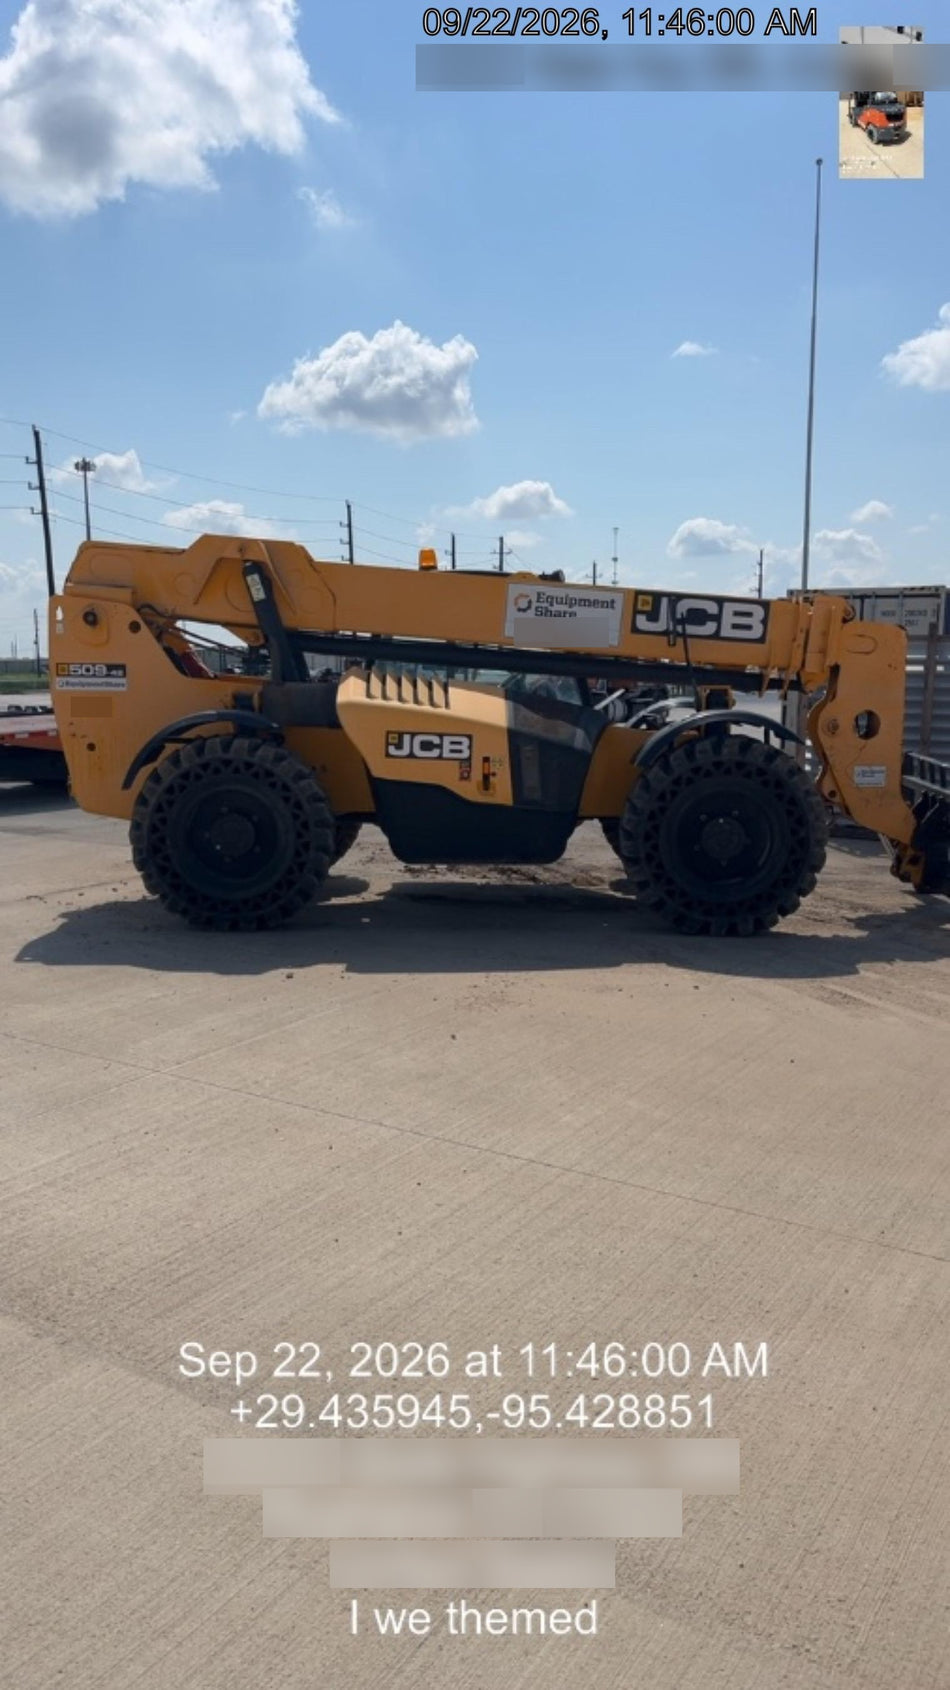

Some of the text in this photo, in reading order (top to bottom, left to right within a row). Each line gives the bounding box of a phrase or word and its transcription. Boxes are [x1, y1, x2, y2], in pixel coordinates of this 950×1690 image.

[536, 591, 616, 610] Equipment
[635, 596, 765, 640] JCB
[388, 733, 470, 759] JCB
